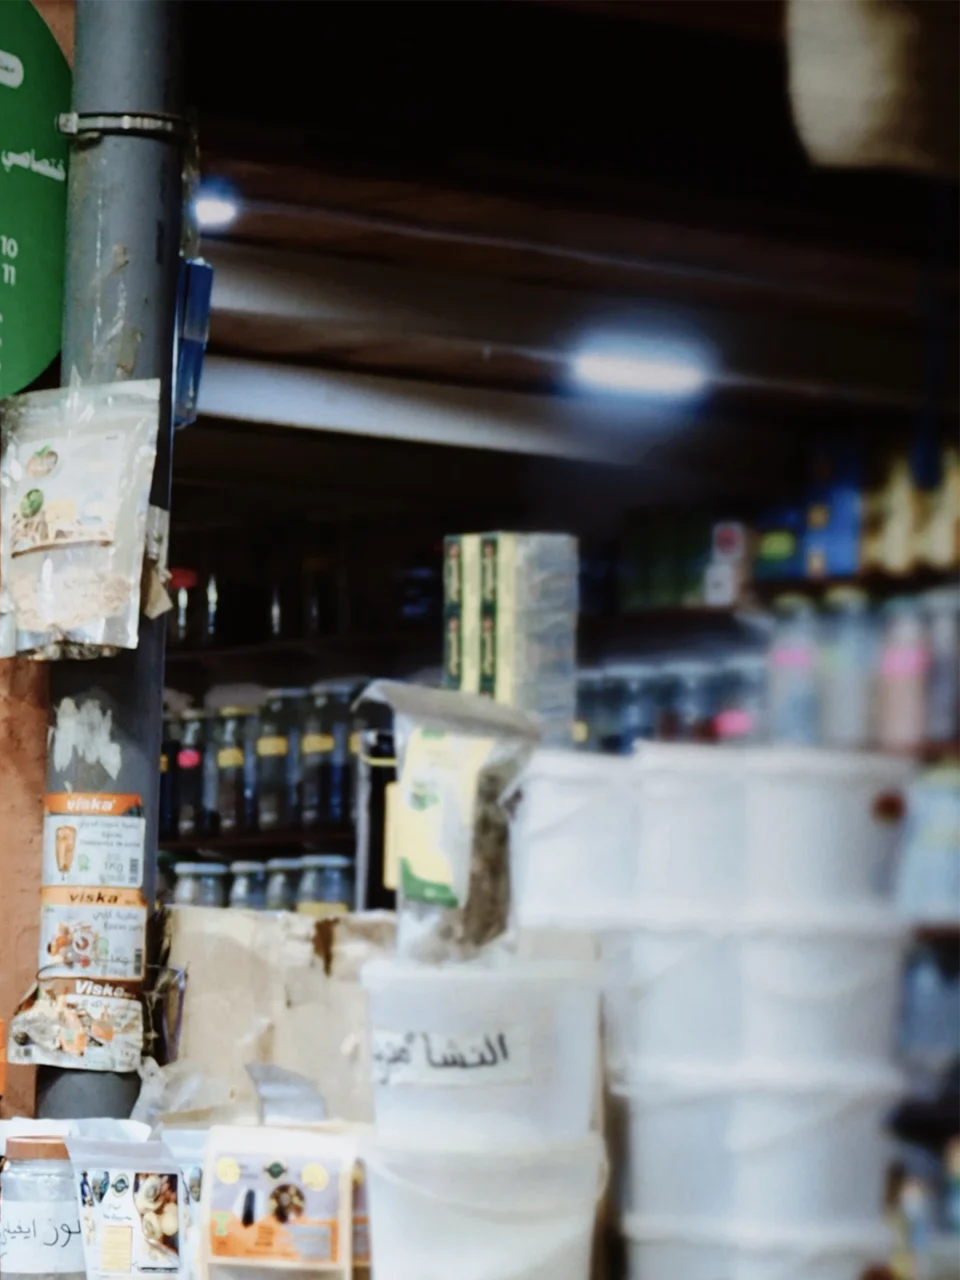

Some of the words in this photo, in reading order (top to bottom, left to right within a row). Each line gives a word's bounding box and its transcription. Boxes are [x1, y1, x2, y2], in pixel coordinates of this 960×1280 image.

[1, 148, 66, 182] ختصاصي
[1, 236, 18, 258] 10
[2, 264, 16, 286] 11
[66, 797, 113, 812] viska
[69, 892, 119, 904] viska
[43, 1217, 82, 1248] لوز
